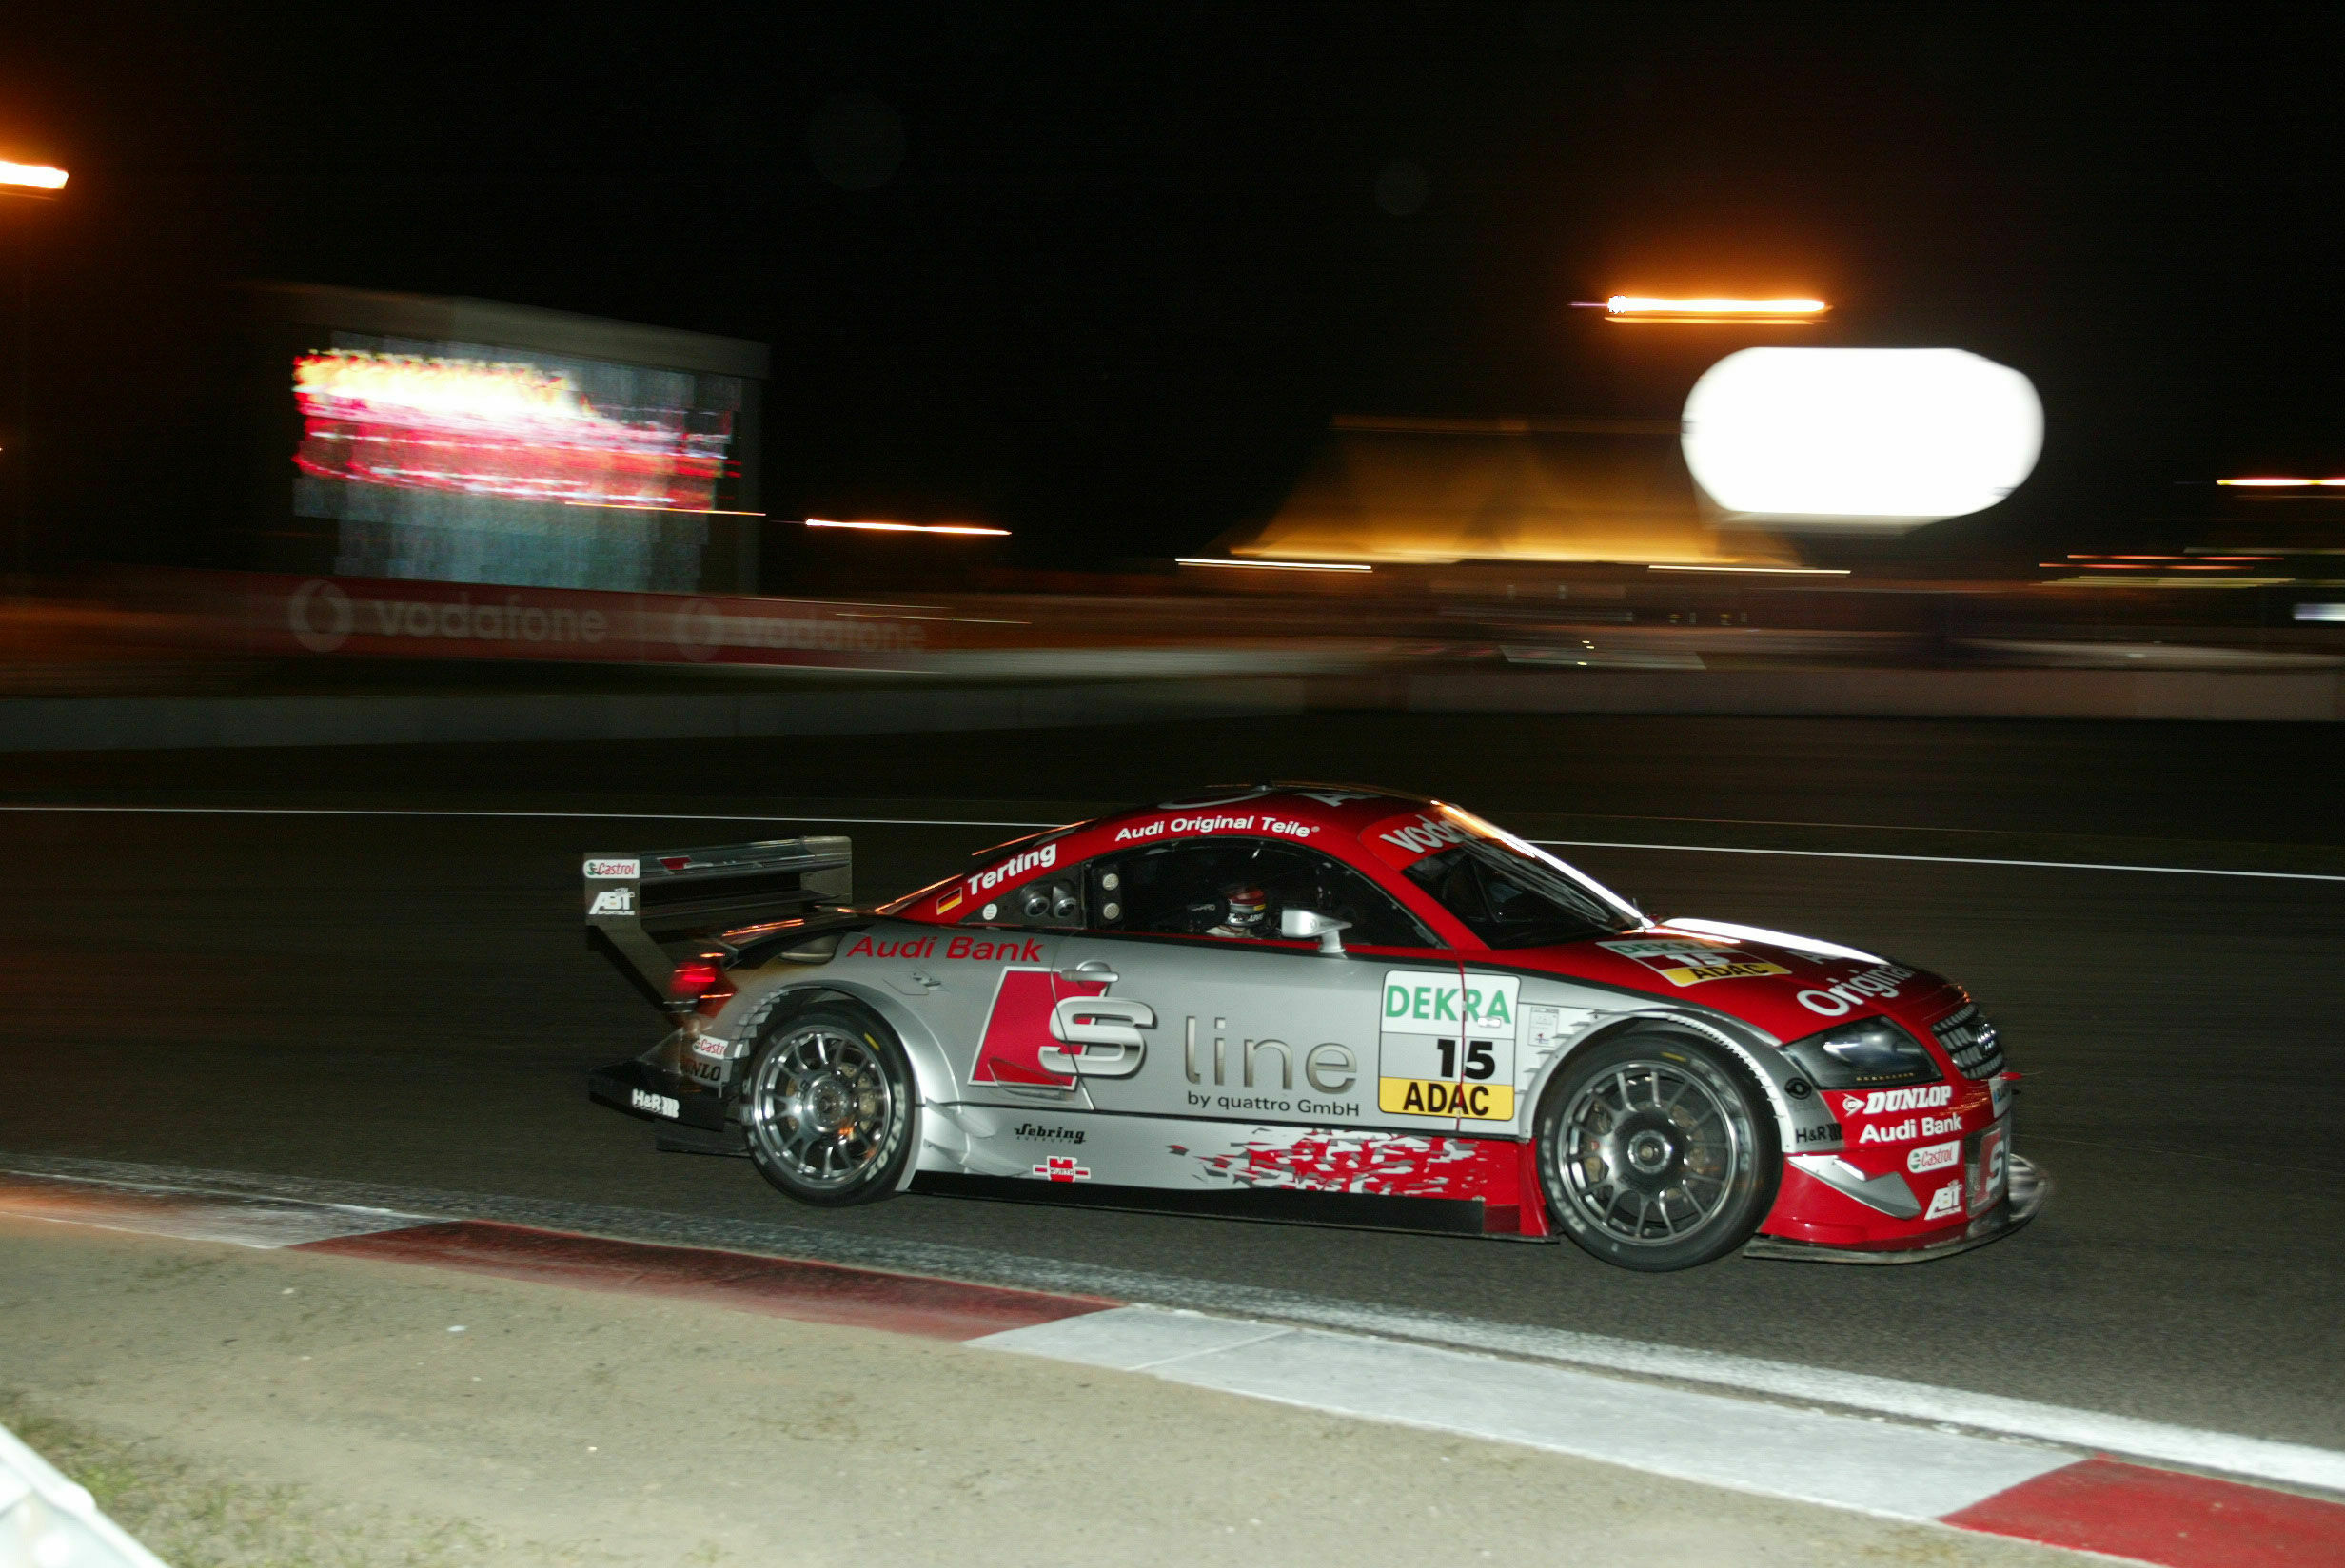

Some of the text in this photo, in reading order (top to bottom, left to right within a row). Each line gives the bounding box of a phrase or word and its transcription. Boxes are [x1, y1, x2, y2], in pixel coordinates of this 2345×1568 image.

[378, 595, 608, 643] vodafone
[1115, 821, 1164, 842] Audi
[1171, 815, 1254, 833] Original
[599, 862, 636, 875] Castrol
[968, 843, 1057, 895] Terting
[847, 936, 1043, 962] Audi Bank
[1689, 964, 1768, 979] ADAC
[1385, 985, 1511, 1024] DEKRA
[1038, 996, 1357, 1095] S line
[1437, 1039, 1495, 1080] 15
[1188, 1090, 1359, 1117] by quattro GmbH
[1403, 1082, 1489, 1116] ADAC
[1862, 1086, 1951, 1114] DUNLOP
[1015, 1124, 1086, 1144] Sebring
[1796, 1126, 1825, 1144] H&R
[1859, 1112, 1962, 1143] Audi Bank
[1921, 1148, 1952, 1167] Castrol
